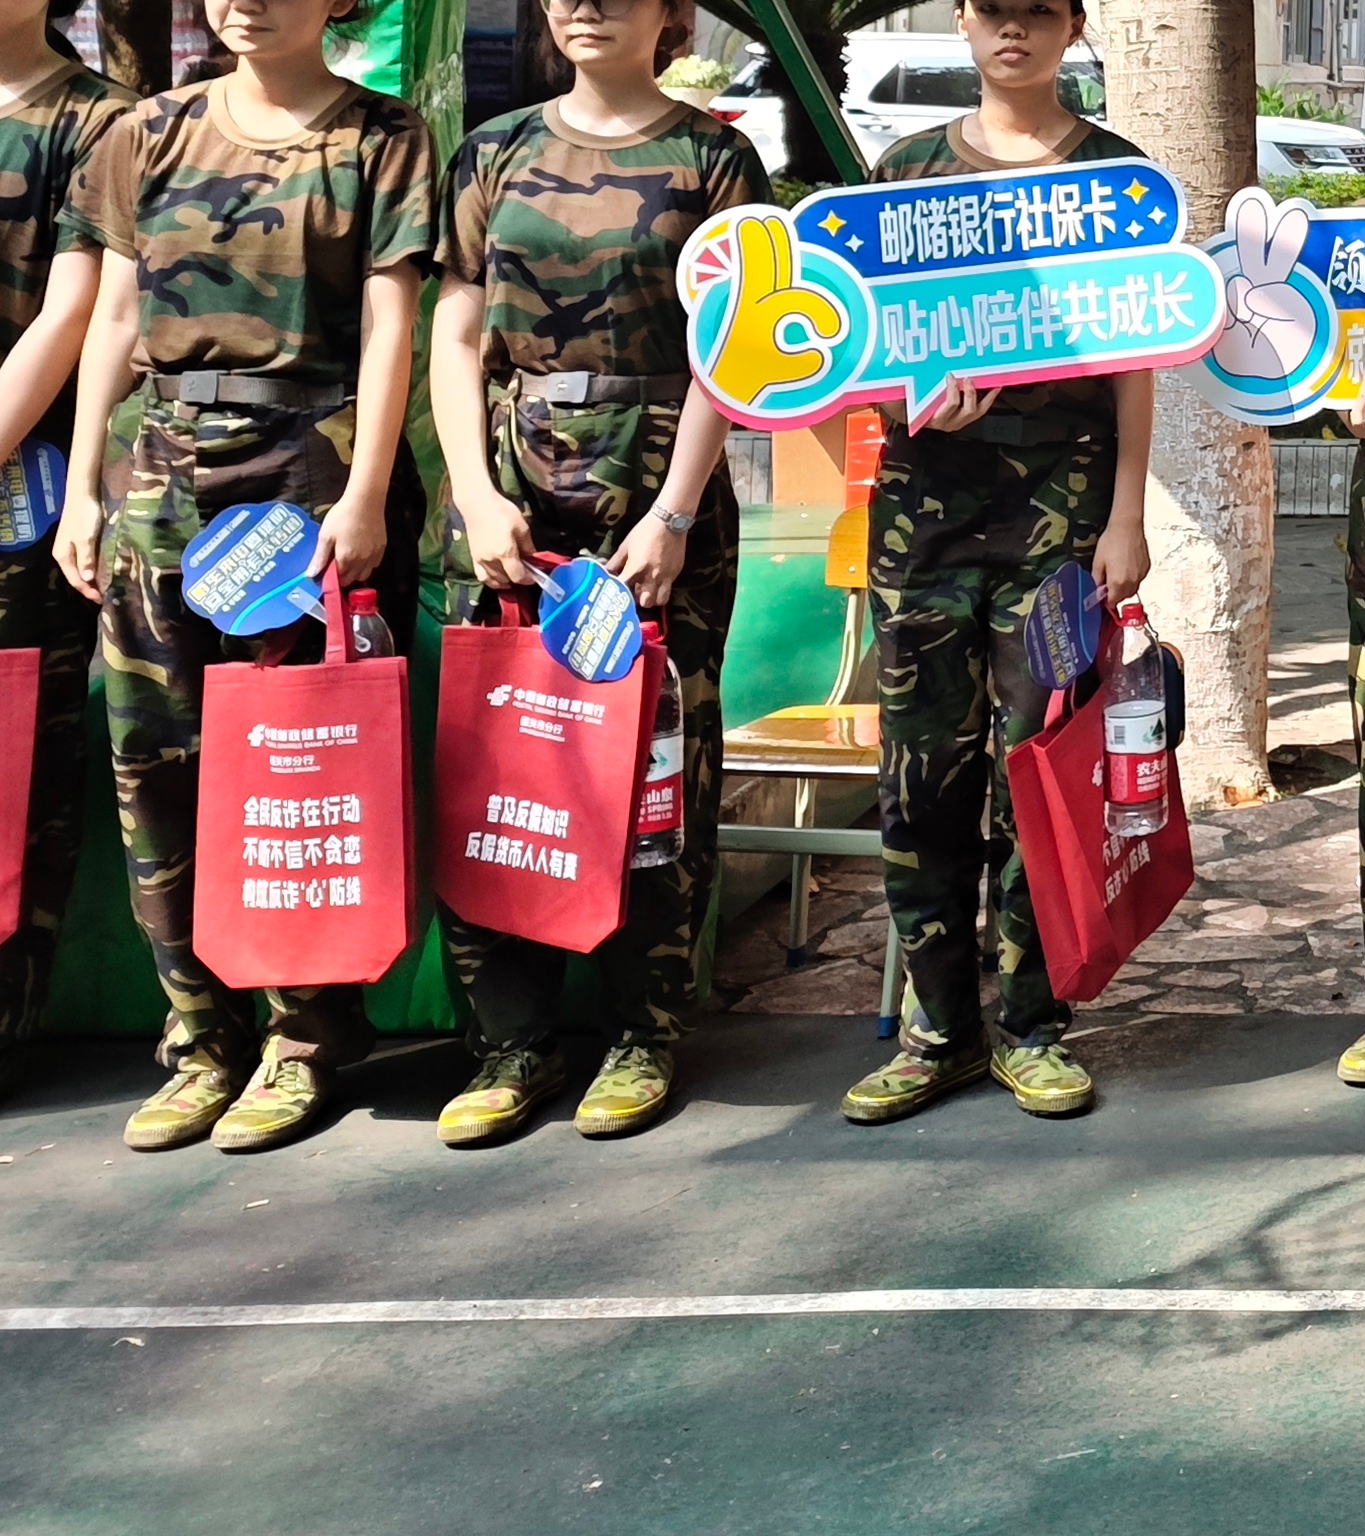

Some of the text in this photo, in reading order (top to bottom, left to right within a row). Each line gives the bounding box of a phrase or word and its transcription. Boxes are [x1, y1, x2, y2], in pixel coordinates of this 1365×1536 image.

[878, 183, 1118, 266] 邮储银行社保卡
[882, 269, 1196, 366] 贴心陪伴共成长
